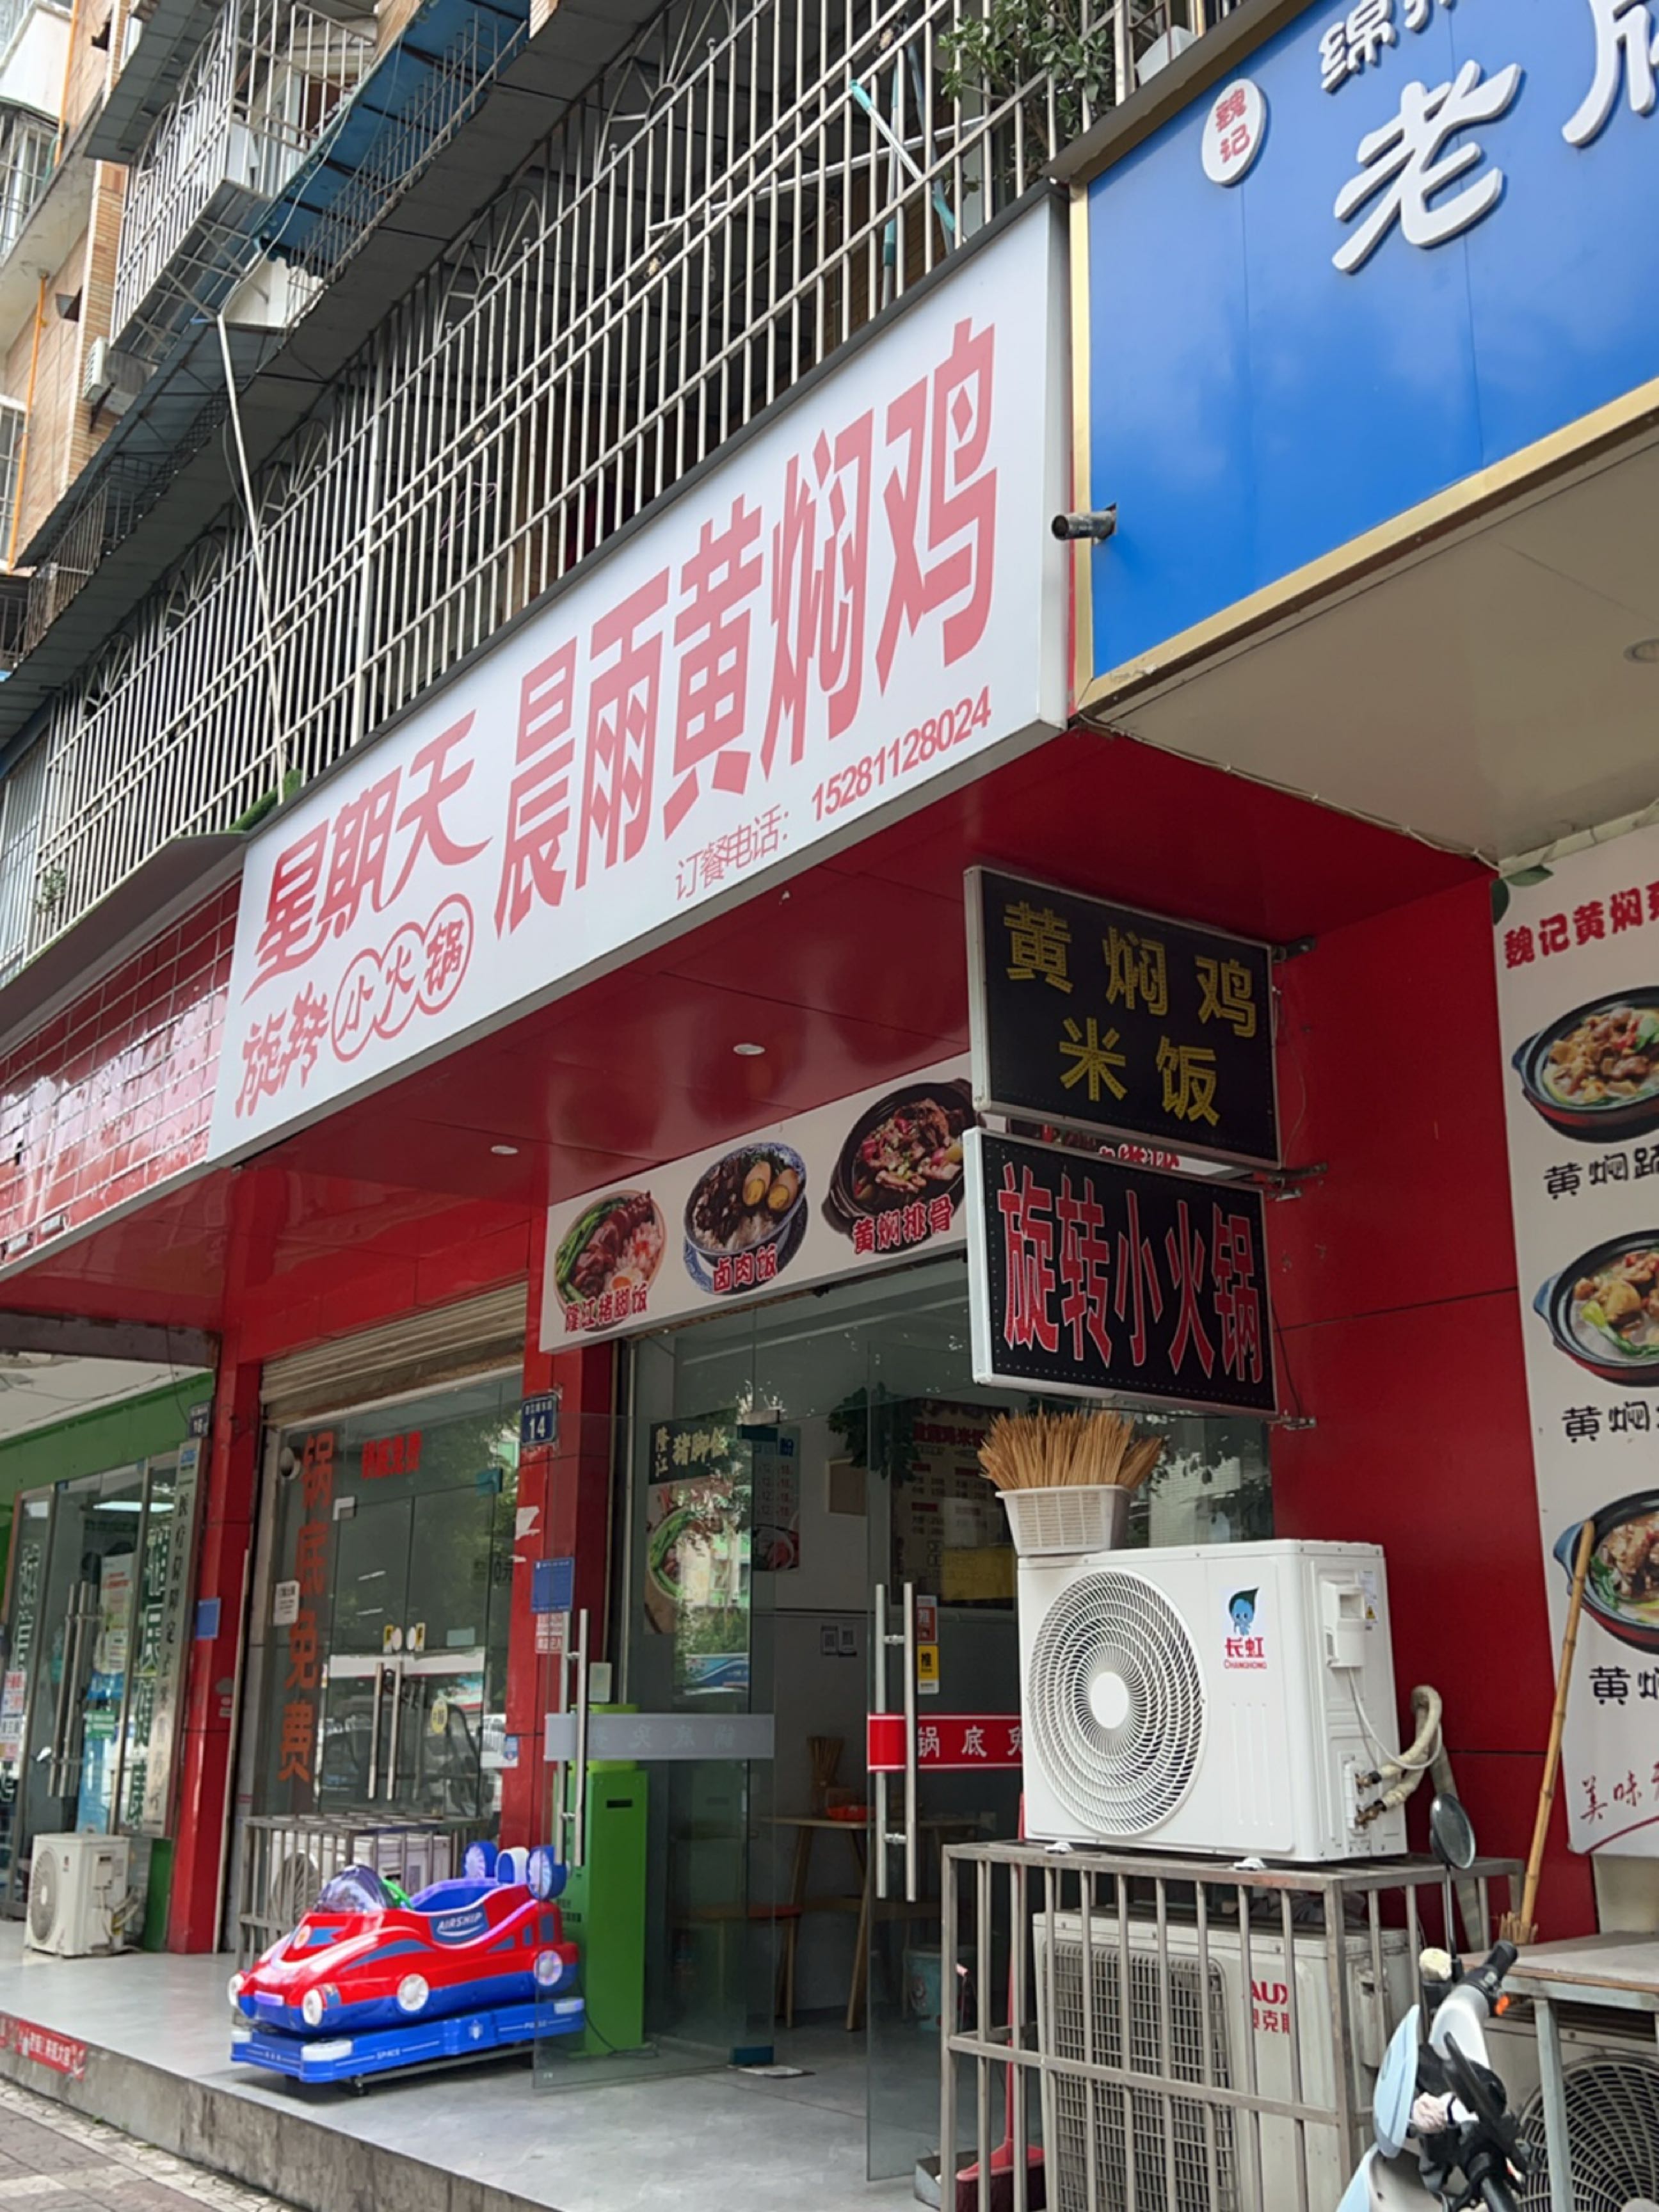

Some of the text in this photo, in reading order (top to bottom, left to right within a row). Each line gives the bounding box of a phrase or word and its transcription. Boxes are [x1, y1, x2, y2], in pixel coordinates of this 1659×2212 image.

[1320, 0, 1453, 93] 绵
[1216, 87, 1251, 164] 魏记
[493, 317, 999, 941] 晨雨黄焖鸡
[812, 685, 991, 822] 15281128024
[241, 710, 493, 1006] 星期天
[1004, 901, 1256, 1038] 黄焖鸡
[1504, 881, 1659, 968] 魏记黄焖
[1060, 1018, 1220, 1126] 米饭
[712, 1244, 778, 1293] 卤肉饭
[853, 1196, 952, 1255] 黄焖排骨
[998, 1162, 1263, 1383] 旋转小火锅
[530, 1415, 545, 1439] 14
[278, 1431, 335, 1783] 锅底免费
[1225, 1637, 1264, 1658] 长虹
[437, 1912, 483, 1930] AIRSHIP
